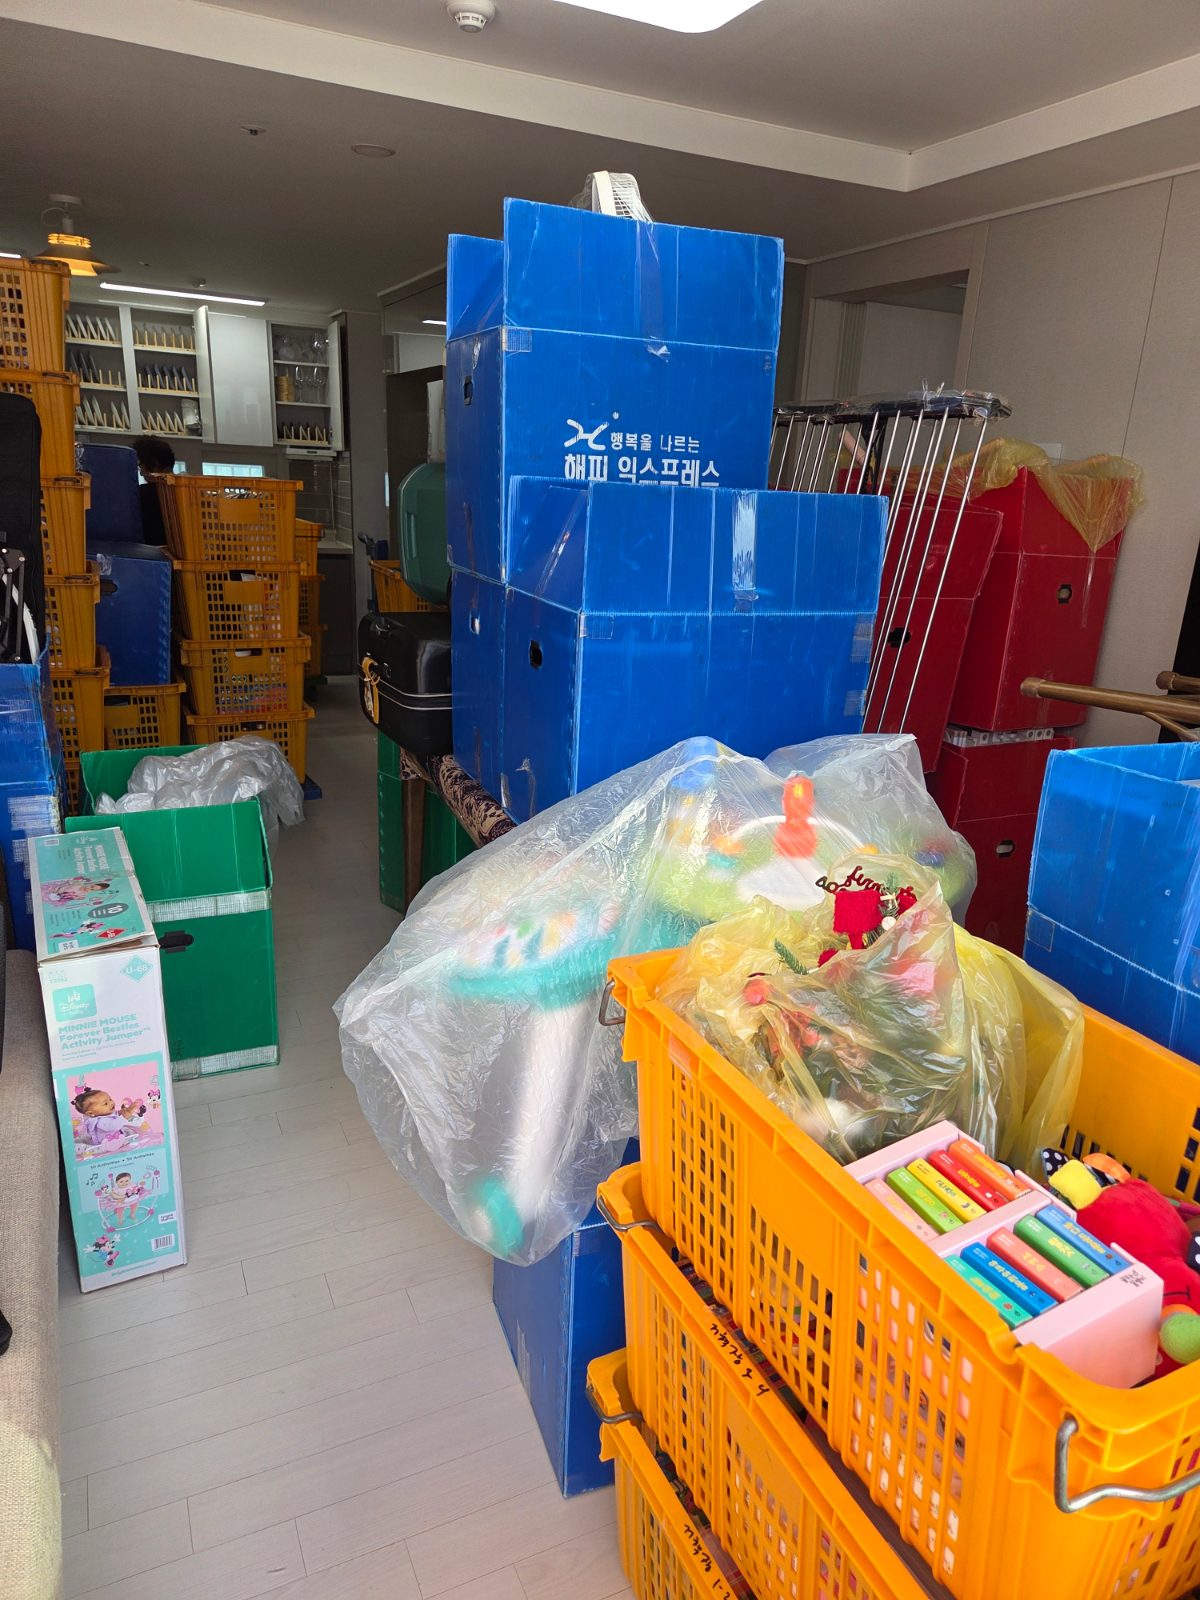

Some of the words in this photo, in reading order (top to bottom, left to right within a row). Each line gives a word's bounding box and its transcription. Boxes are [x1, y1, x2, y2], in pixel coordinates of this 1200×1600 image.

[610, 432, 653, 452] 행복을
[660, 434, 700, 453] 나르는
[564, 453, 609, 481] 해피
[618, 456, 720, 487] 익스프레스
[58, 1021, 97, 1034] MINNIE
[99, 1013, 137, 1027] MOUSE
[59, 1031, 101, 1043] Forever
[102, 1022, 140, 1035] Besties
[61, 1037, 102, 1051] Activity
[105, 1029, 143, 1043] Jumper
